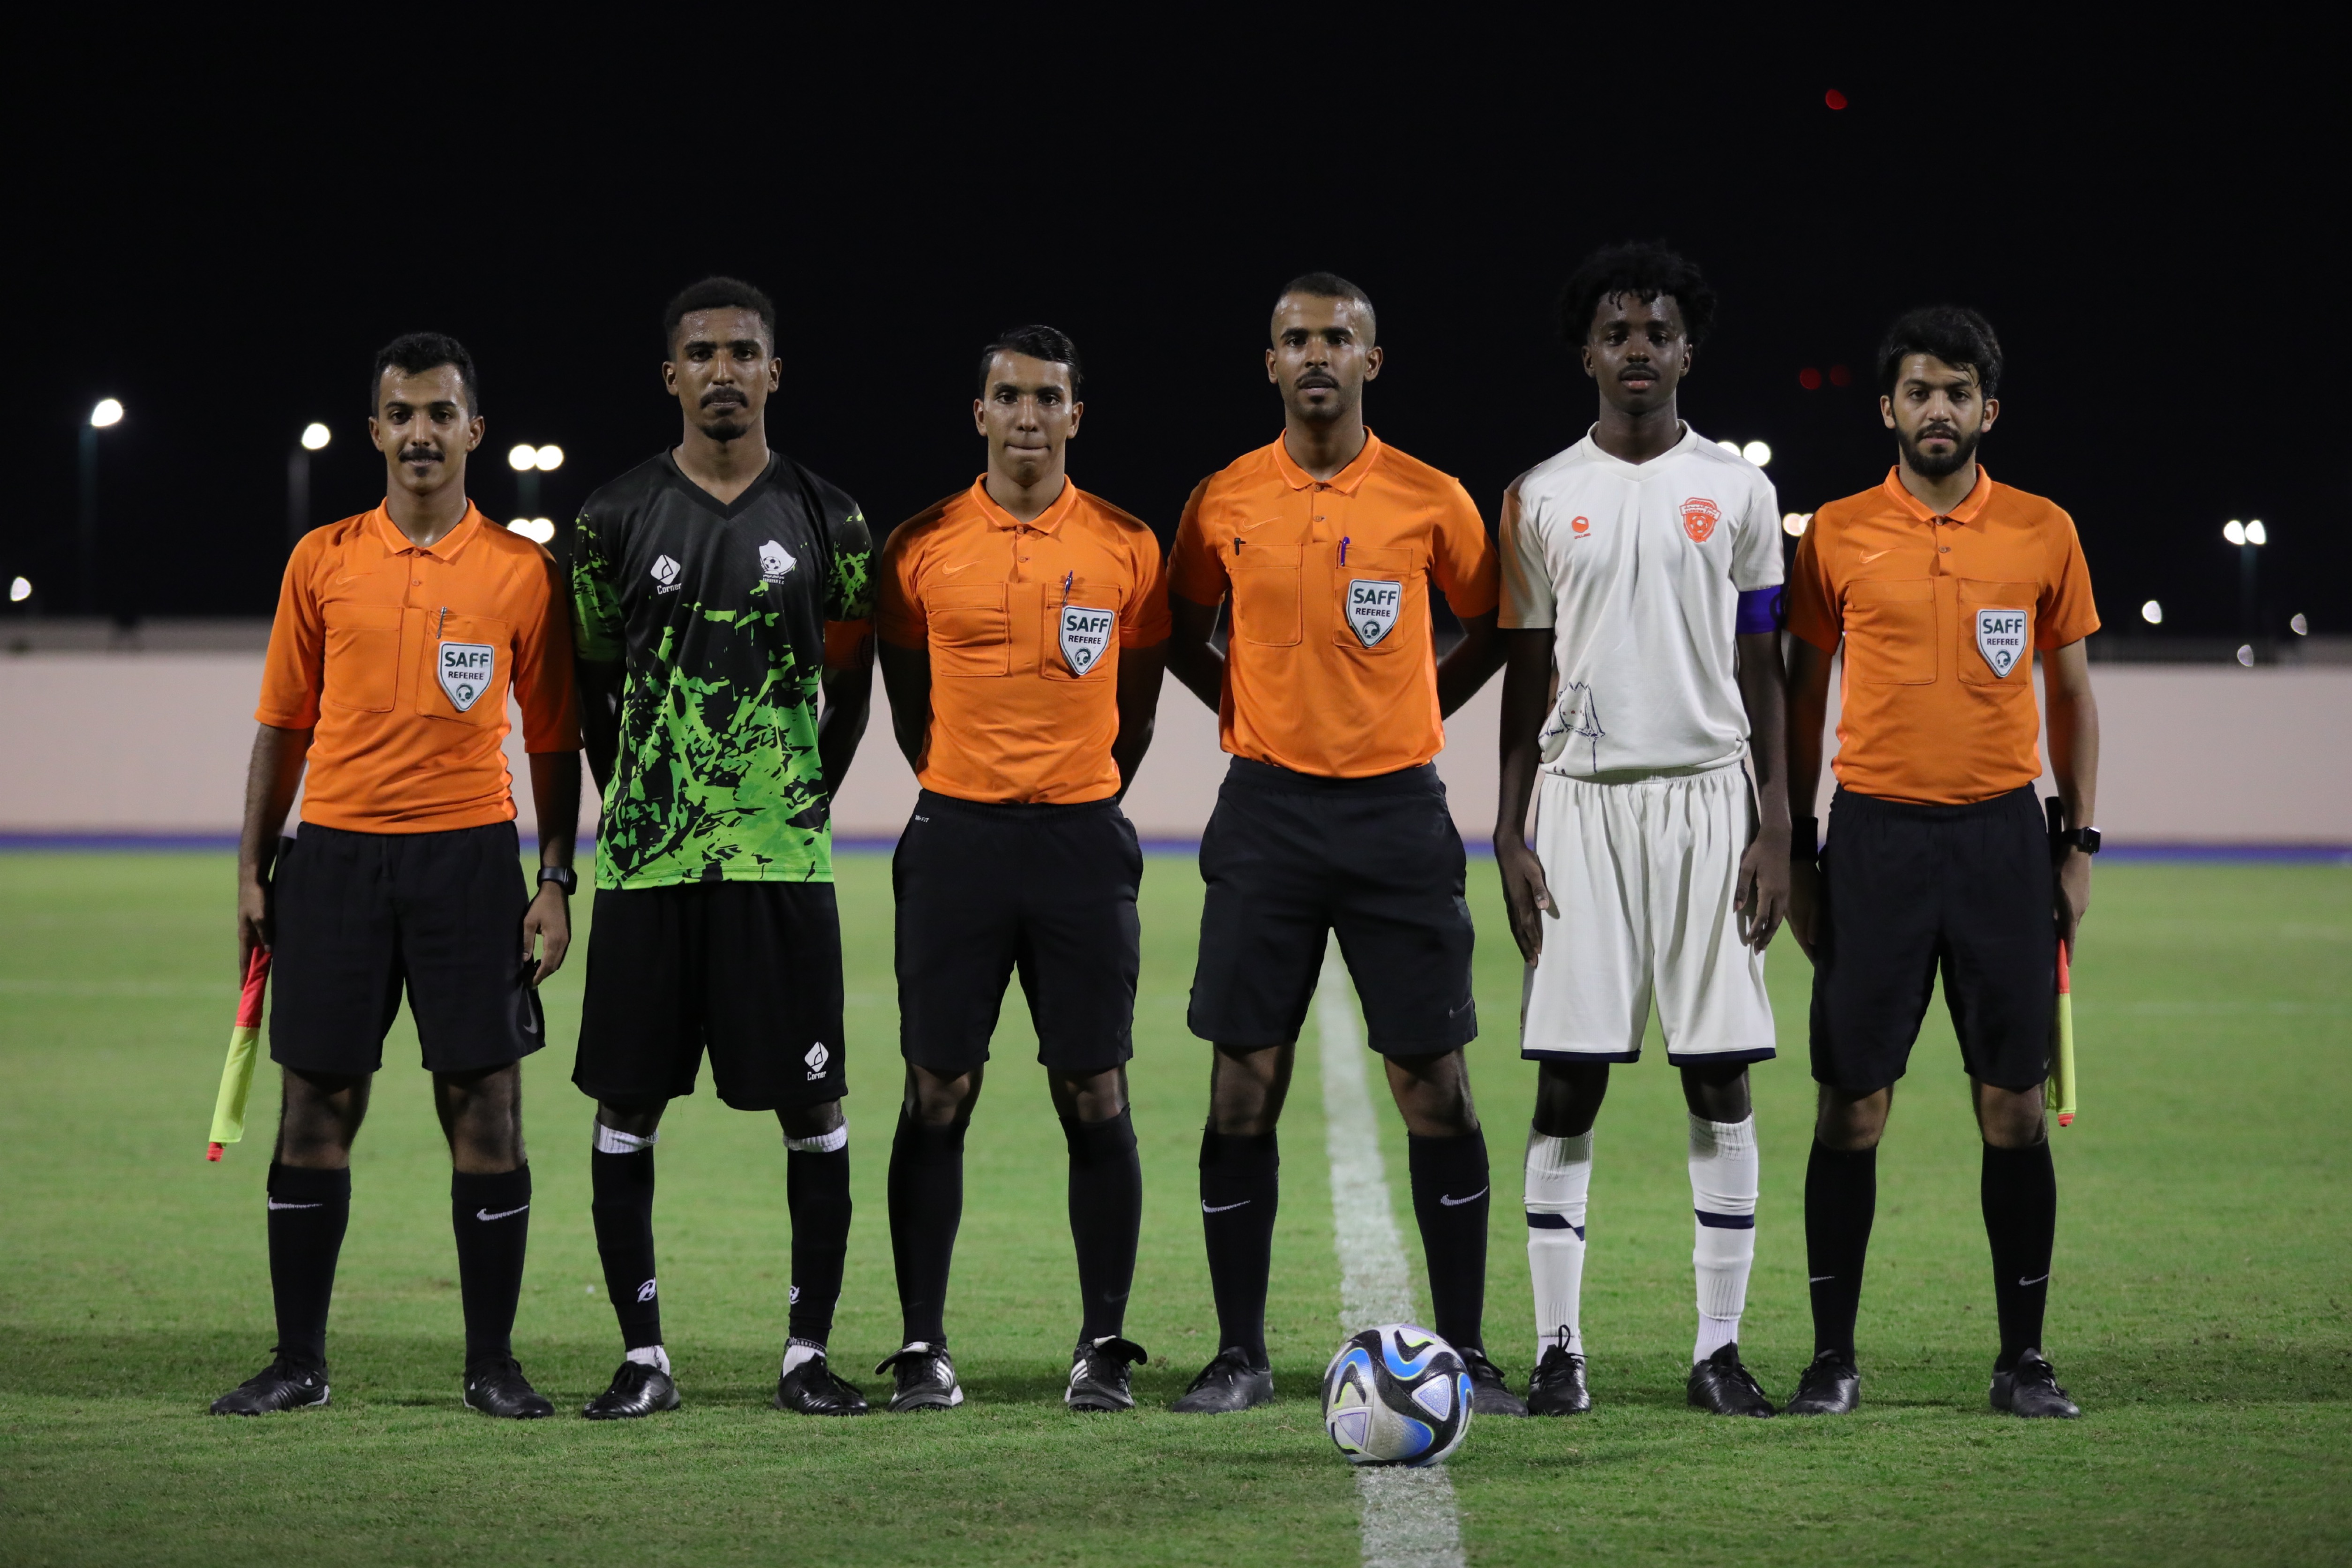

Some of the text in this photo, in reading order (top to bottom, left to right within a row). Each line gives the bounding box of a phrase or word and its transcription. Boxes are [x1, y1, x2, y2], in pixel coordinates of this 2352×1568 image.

[657, 583, 682, 595] Corner
[1354, 588, 1397, 605] SAFF
[1356, 608, 1391, 617] REFEREE
[1066, 615, 1108, 633] SAFF
[1983, 618, 2023, 634] SAFF
[1068, 635, 1101, 644] REFEREE
[445, 651, 489, 668] SAFF
[448, 671, 484, 680] REFEREE
[807, 1071, 827, 1081] Corner
